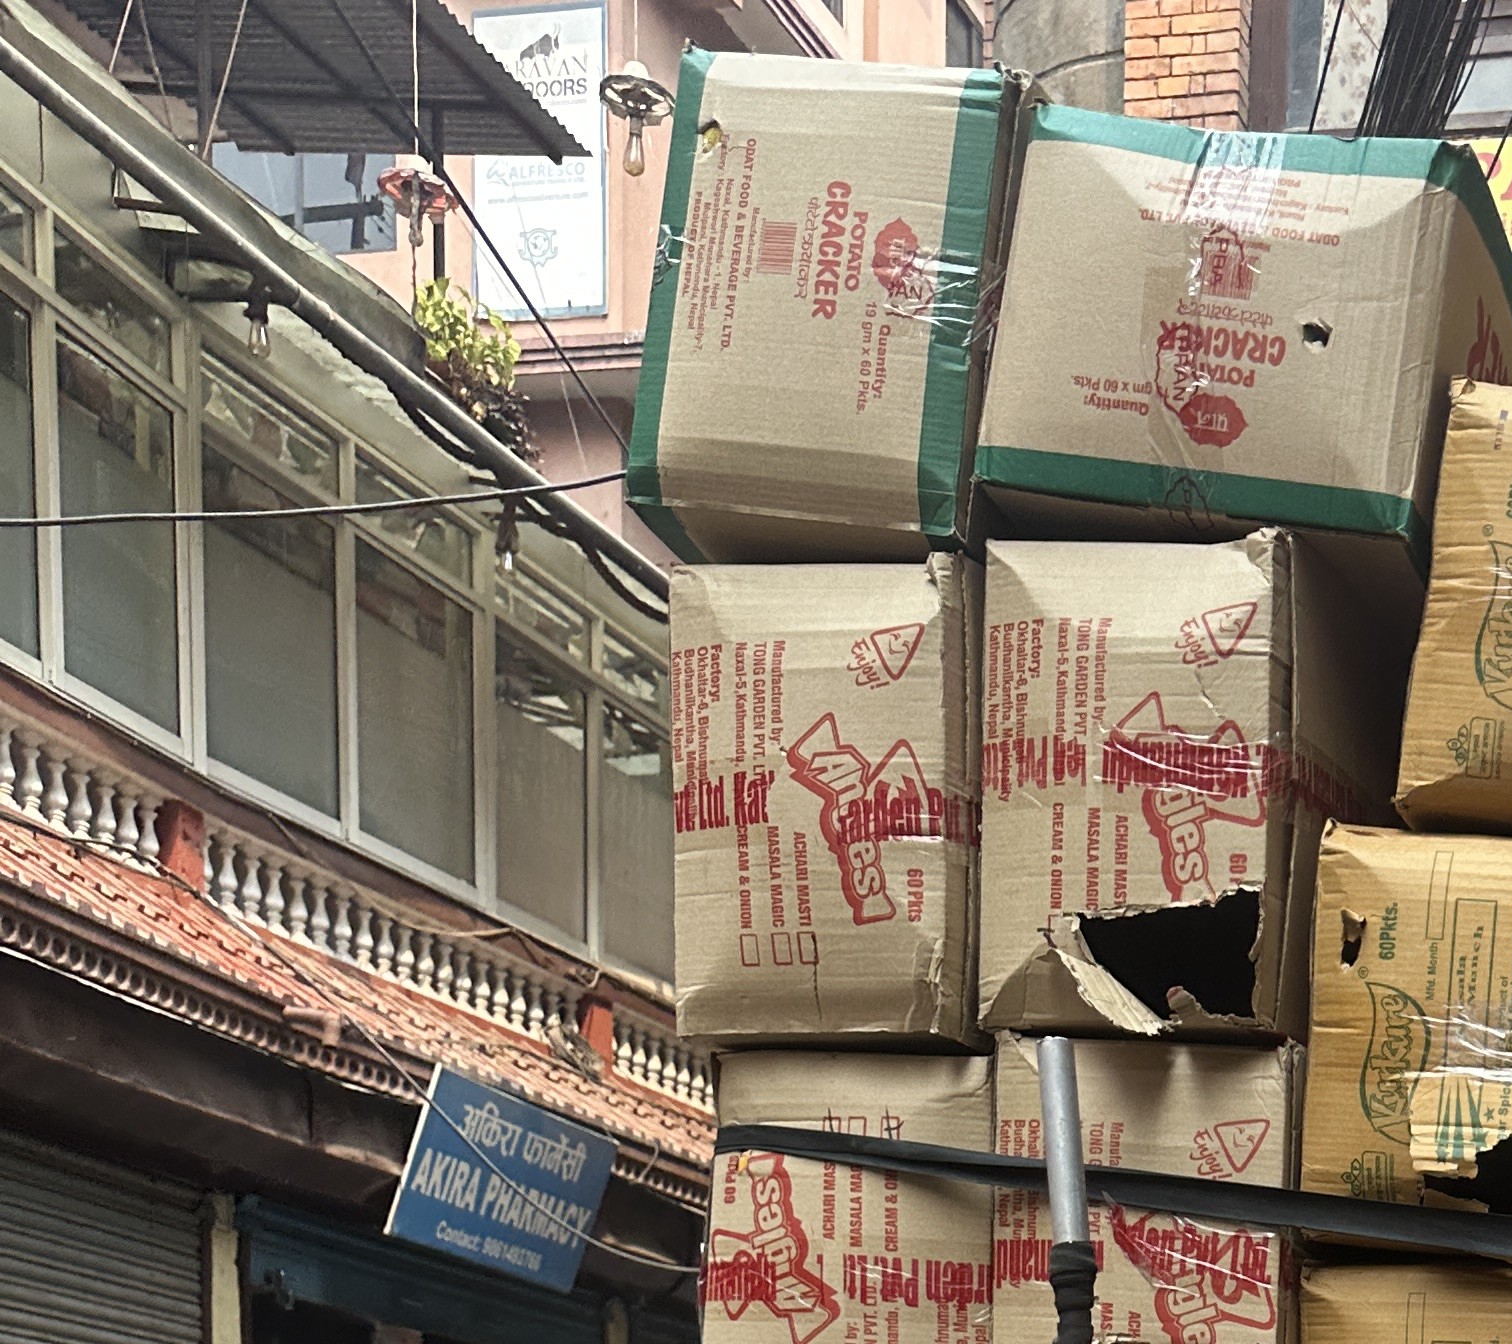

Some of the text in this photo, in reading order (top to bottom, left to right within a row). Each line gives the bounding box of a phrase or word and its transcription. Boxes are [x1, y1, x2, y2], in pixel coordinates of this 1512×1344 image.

[506, 55, 587, 79] RAVAN
[744, 138, 757, 170] ODAT
[737, 212, 747, 221] &
[739, 174, 753, 208] FOOD
[729, 224, 746, 291] BEVERAGE
[811, 180, 853, 321] CRACKER
[844, 210, 869, 293] POTATO
[861, 321, 874, 345] gm
[860, 360, 872, 376] 60
[871, 324, 892, 400] Quantity:
[855, 380, 870, 415] Pkts.
[1083, 394, 1150, 417] Quantity:
[846, 637, 891, 691] Enjoy!
[1174, 617, 1219, 669] Enjoy!
[709, 643, 723, 703] Factory:
[771, 640, 786, 725] Manufactured
[752, 641, 767, 762] TONG GARDEN PVT.
[1051, 802, 1065, 853] CREAM
[766, 825, 786, 929] MASALA MAGIC
[792, 830, 812, 928] ACHARI MASTI
[906, 868, 925, 924] 60 Pkts
[1050, 867, 1063, 911] ONION
[410, 1147, 592, 1249] AKIRA PHARMACY
